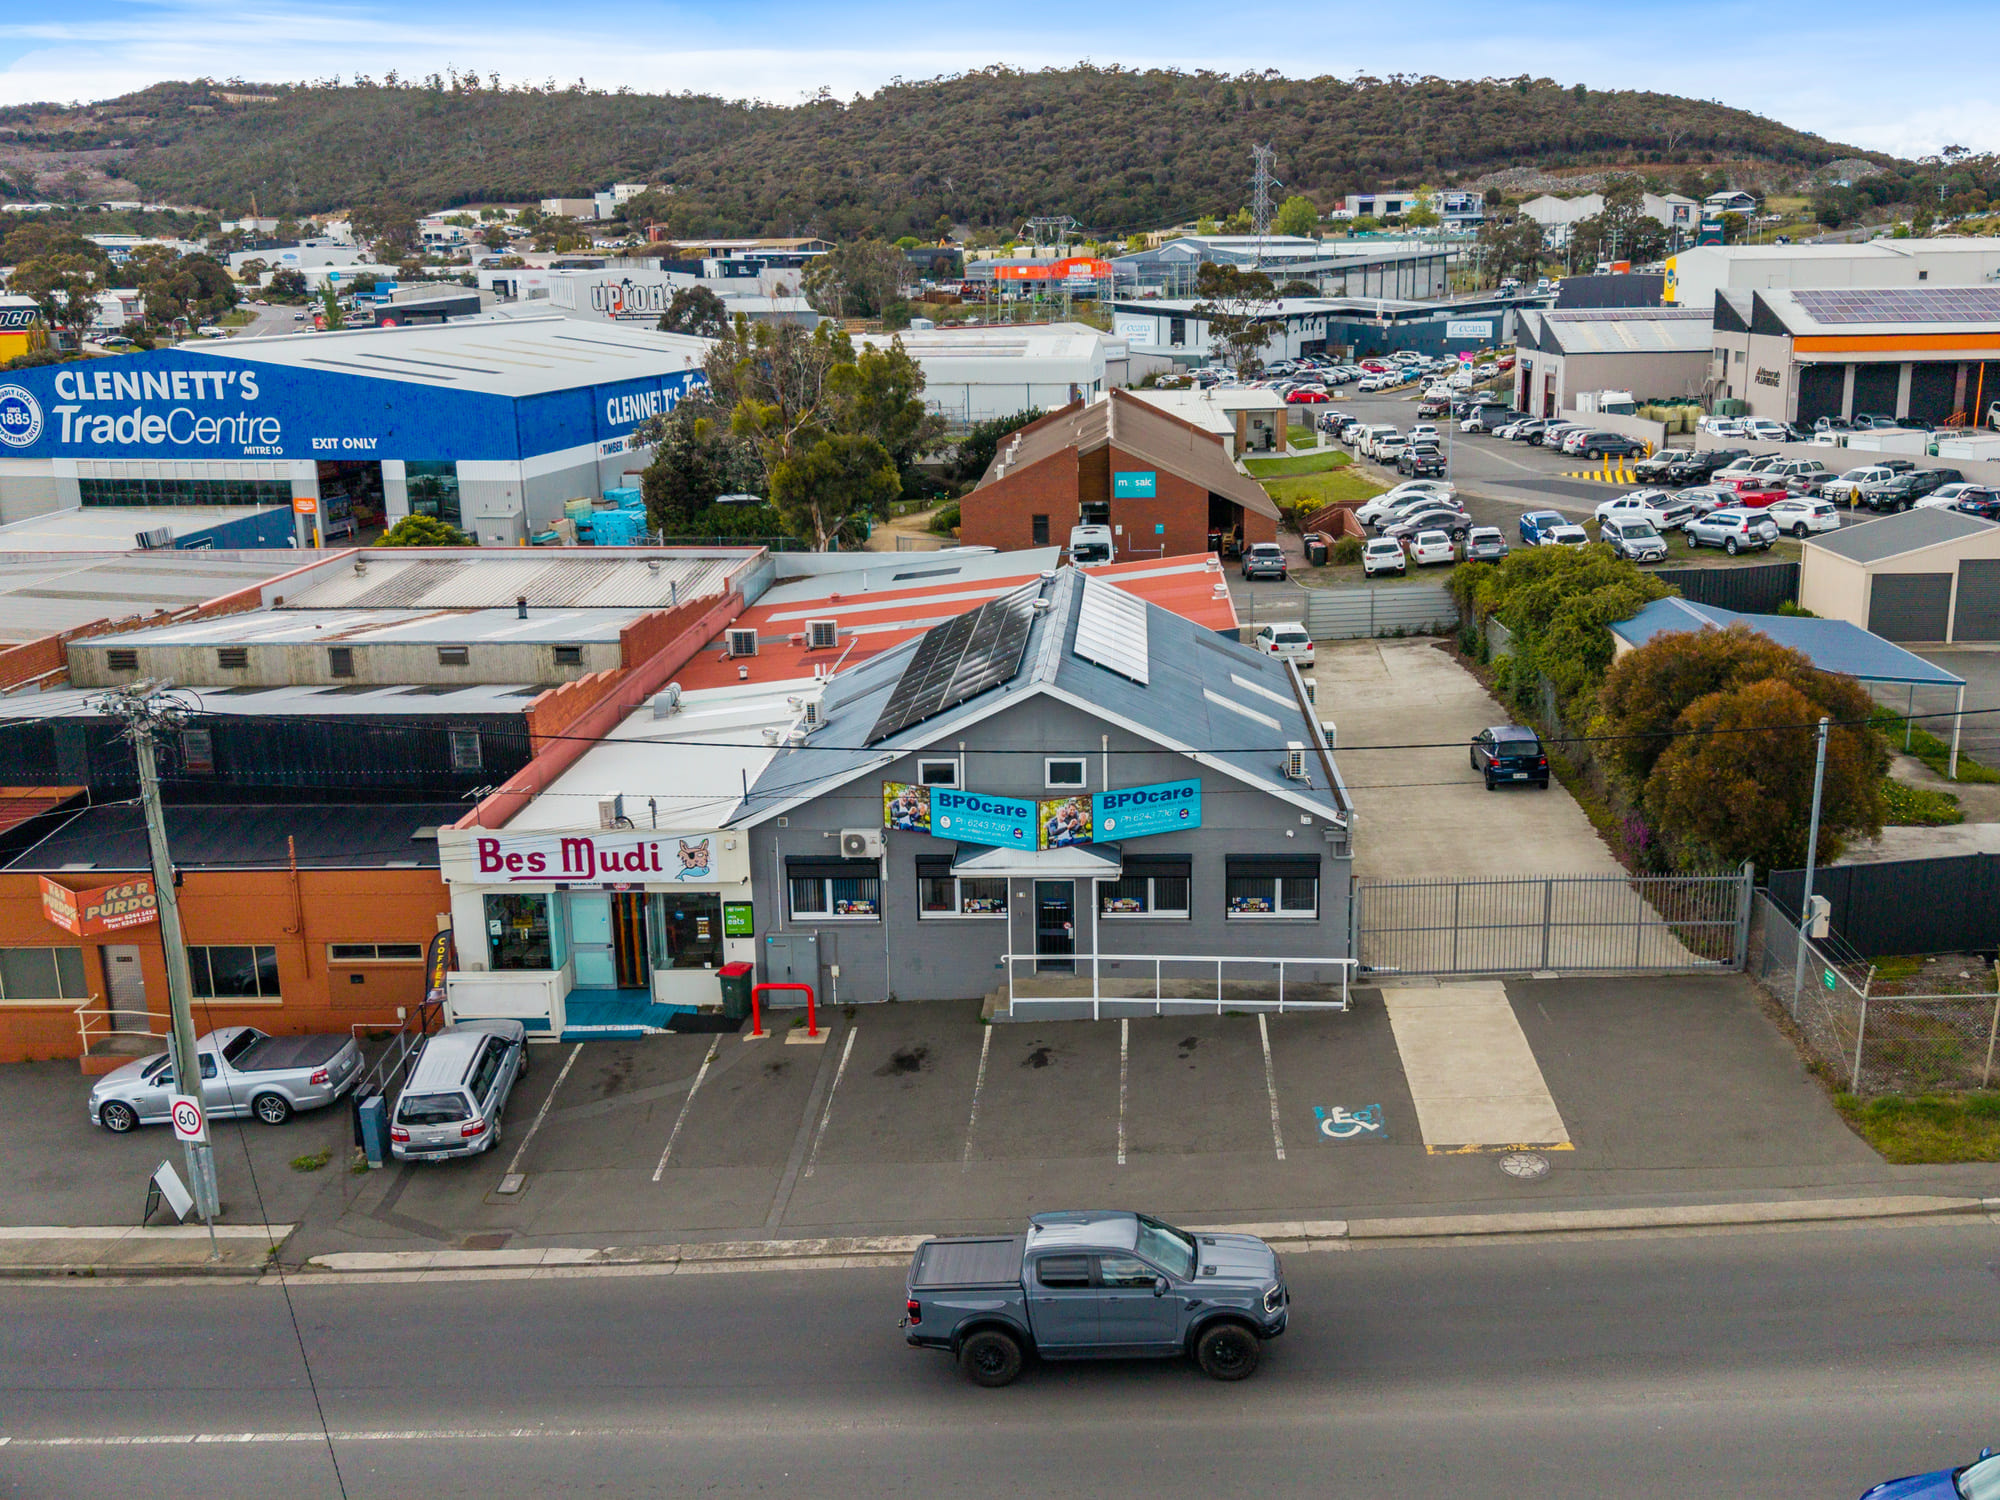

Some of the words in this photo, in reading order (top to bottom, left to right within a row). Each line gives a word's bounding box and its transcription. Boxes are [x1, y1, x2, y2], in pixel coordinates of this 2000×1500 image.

[54, 370, 260, 401] CLENNETT'S
[0, 412, 30, 425] 1885
[243, 445, 271, 456] MITRE
[271, 445, 284, 455] 10
[312, 437, 338, 450] EXIT
[342, 437, 378, 450] ONLY
[938, 793, 1028, 818] BPOcare
[1103, 787, 1194, 810] BPOcare
[967, 819, 989, 830] 6243
[477, 838, 546, 873] Bes
[560, 837, 662, 880] Mudi
[106, 887, 119, 900] K
[120, 886, 133, 897] &
[136, 882, 148, 895] R
[86, 894, 157, 920] PURDO
[433, 937, 447, 989] COFFEE
[178, 1110, 197, 1126] 60
